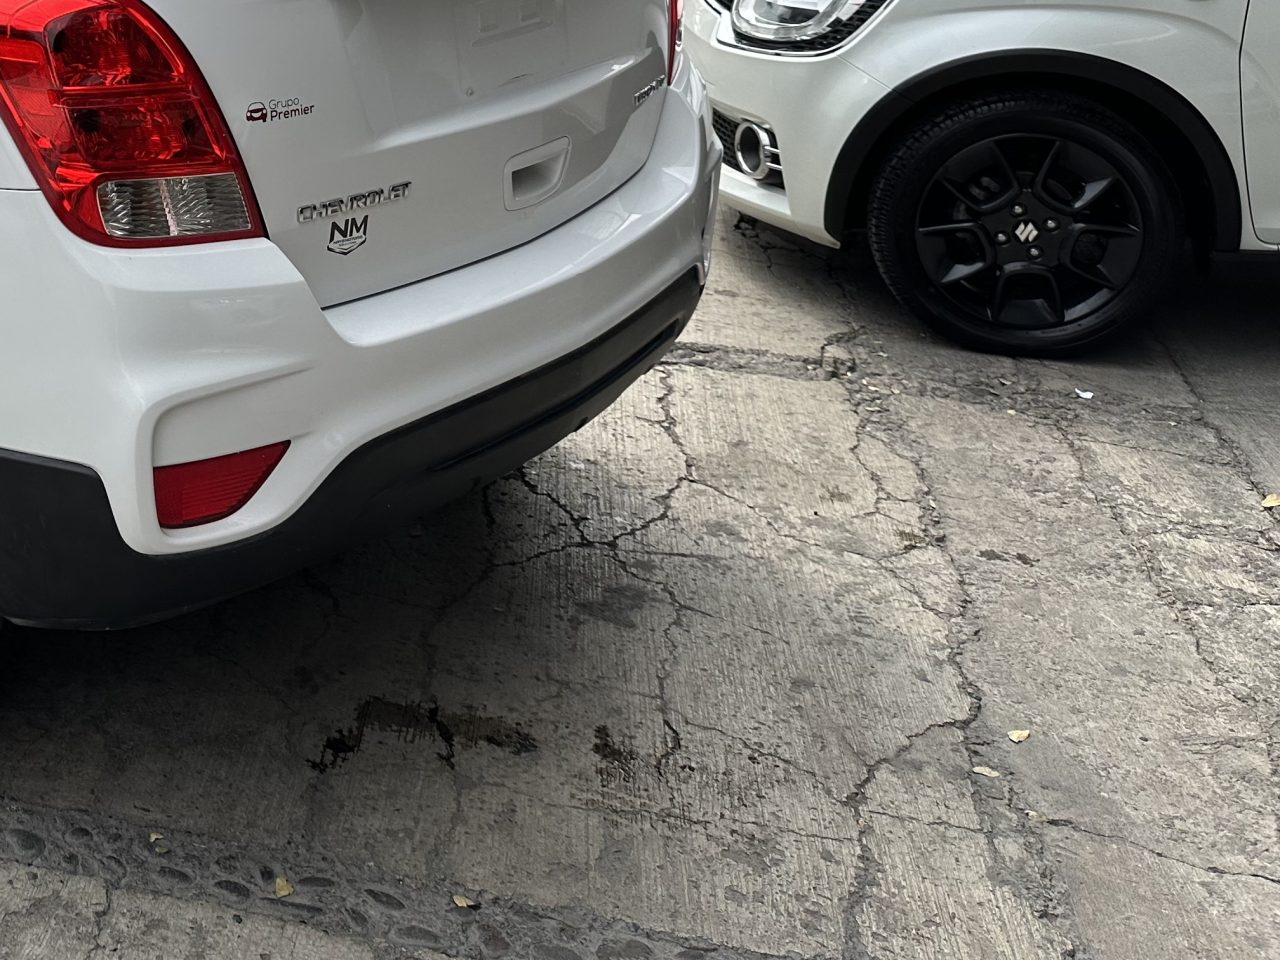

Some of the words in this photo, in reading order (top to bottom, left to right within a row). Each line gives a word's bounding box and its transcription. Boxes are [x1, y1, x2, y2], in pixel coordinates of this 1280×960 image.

[268, 98, 300, 110] Grupo
[270, 104, 315, 122] Premier
[296, 181, 412, 224] CHEVROLET
[328, 214, 369, 244] NM
